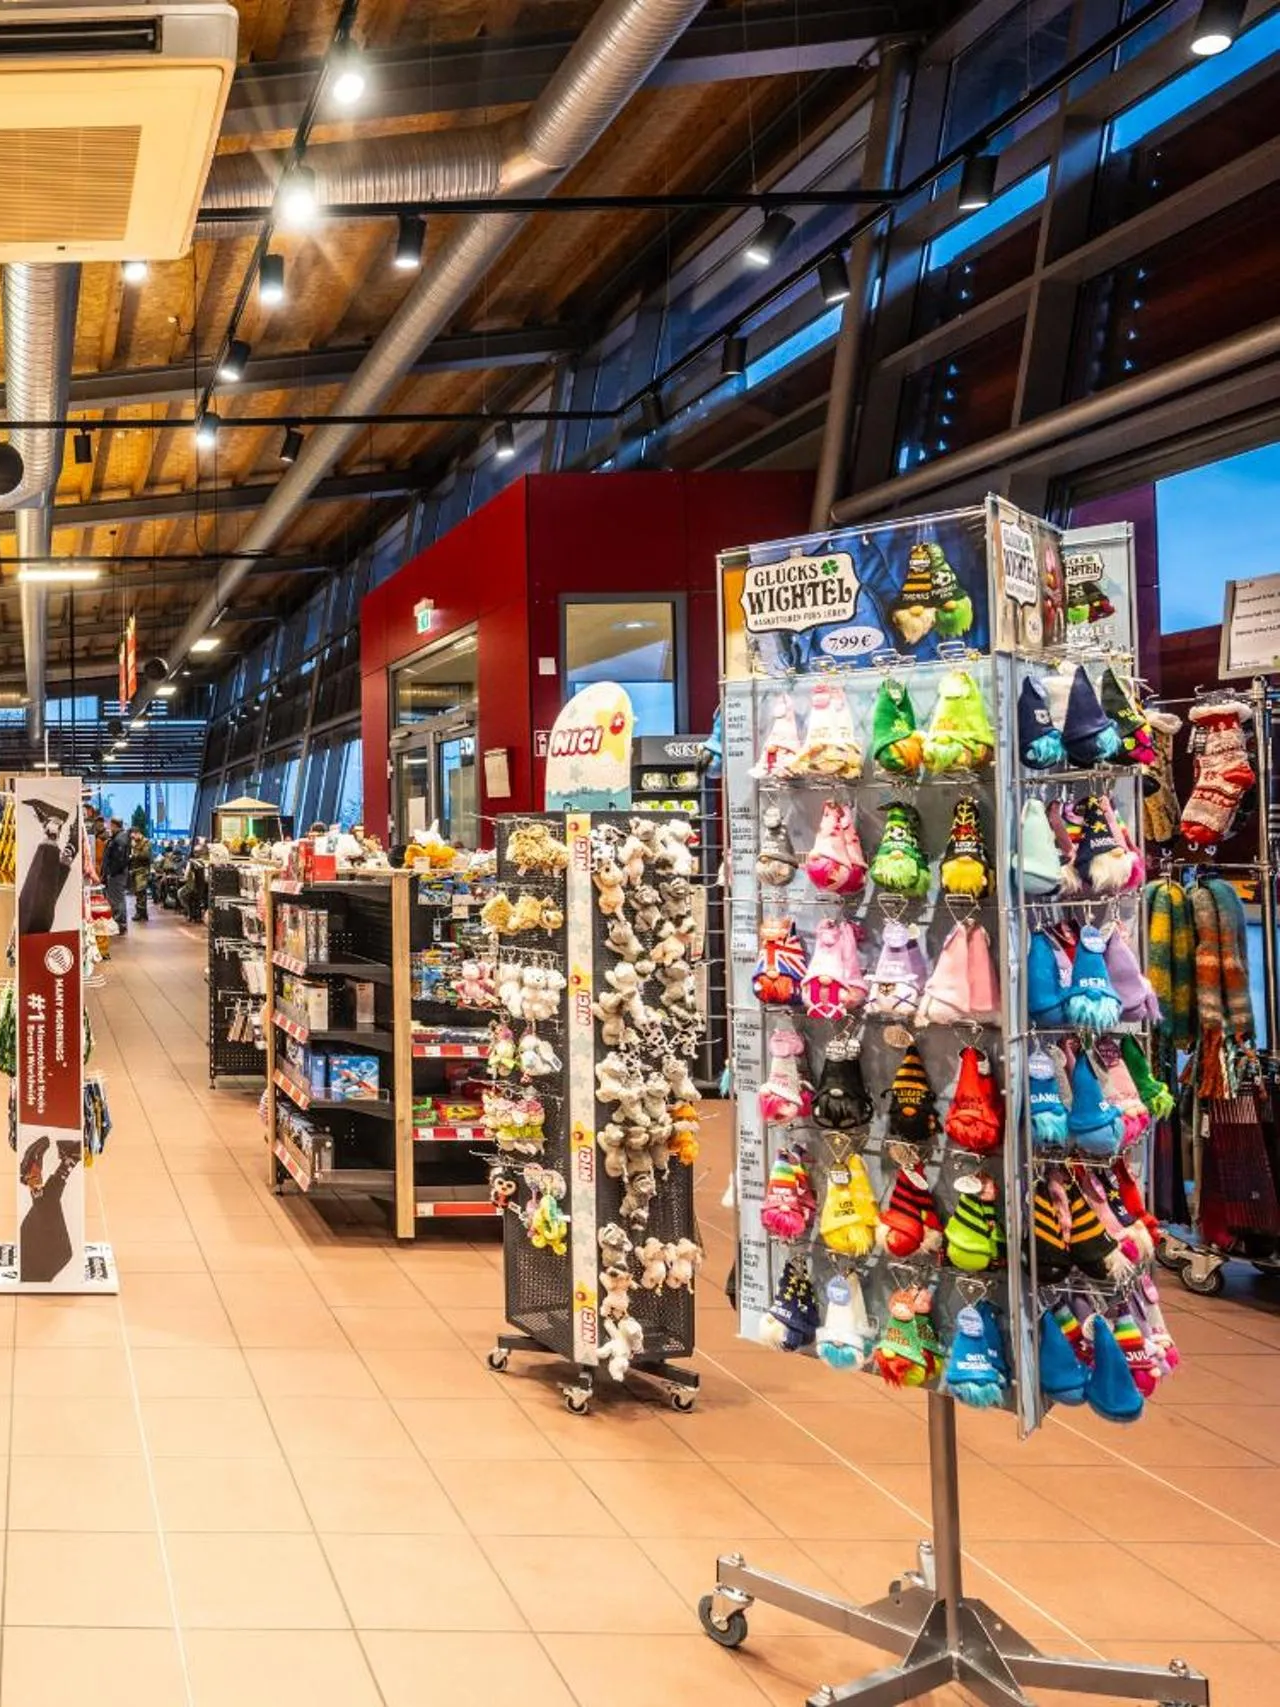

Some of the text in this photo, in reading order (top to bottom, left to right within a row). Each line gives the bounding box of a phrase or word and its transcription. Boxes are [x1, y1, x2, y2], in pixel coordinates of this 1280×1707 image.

[753, 562, 819, 587] GLÜCKS
[747, 577, 853, 616] WICHTEL
[551, 724, 604, 758] NICI
[27, 993, 46, 1022] #1
